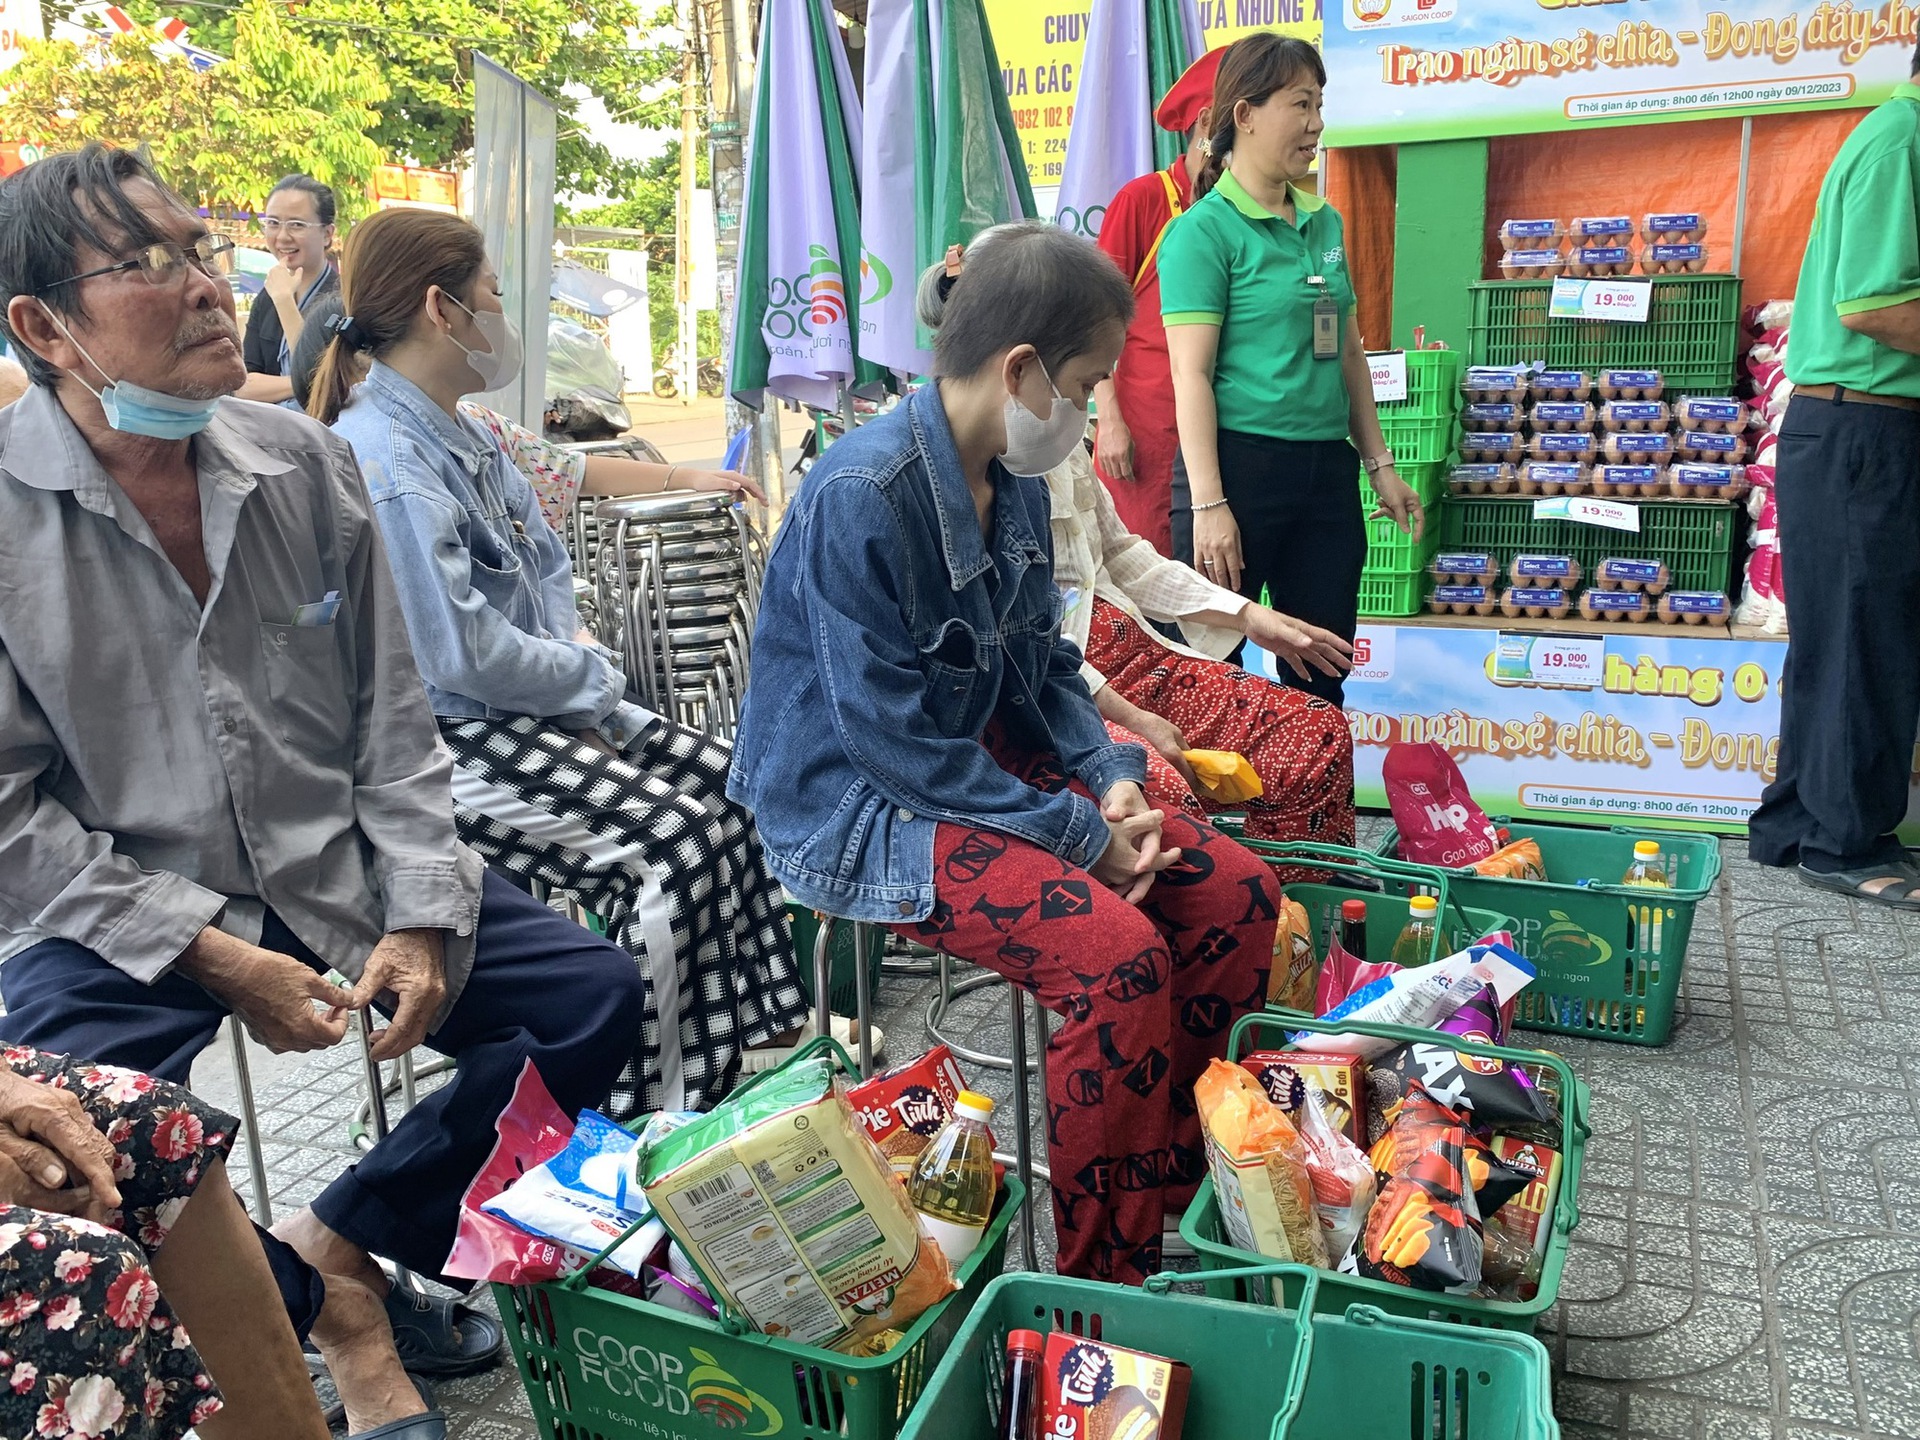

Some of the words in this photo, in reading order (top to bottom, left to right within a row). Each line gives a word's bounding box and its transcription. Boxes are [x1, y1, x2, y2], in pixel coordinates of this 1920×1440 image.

[1401, 13, 1429, 22] SAIGON
[1377, 44, 1455, 84] Trao
[1462, 35, 1548, 83] ngàn
[1550, 28, 1589, 68] sẻ
[1596, 20, 1674, 64] chia
[1702, 12, 1799, 58] Đong
[1808, 0, 1880, 58] đầy
[1035, 59, 1073, 95] CÁC
[1577, 102, 1599, 114] Thời
[1601, 102, 1623, 114] gian
[1625, 99, 1638, 110] áp
[1640, 97, 1671, 110] dụng:
[1672, 95, 1698, 105] 8h00
[1700, 91, 1720, 103] đến
[1722, 89, 1753, 101] 12h00
[1756, 88, 1782, 100] ngày
[1785, 82, 1842, 96] 09/12/2023
[1043, 107, 1063, 128] 102
[1044, 138, 1067, 153] 224
[1042, 162, 1062, 177] 169
[1693, 406, 1711, 414] Select
[1691, 437, 1708, 445] Select
[1609, 471, 1627, 479] Select
[1522, 562, 1540, 570] Select
[1610, 565, 1629, 574] Select
[1515, 593, 1533, 601] Select
[1593, 597, 1612, 605] Select
[1674, 599, 1693, 608] Select
[1604, 654, 1722, 704] hàng
[1734, 661, 1767, 699] 0
[1400, 708, 1500, 753] ngàn
[1503, 711, 1547, 753] sẻ
[1556, 711, 1646, 762] chia
[1533, 792, 1559, 804] Thời
[1561, 795, 1586, 808] gian
[1589, 794, 1604, 808] áp
[1606, 798, 1641, 813] dụng:
[1643, 801, 1673, 811] 8h00
[1676, 801, 1698, 813] đến
[1702, 804, 1738, 816] 12h00
[1442, 846, 1466, 864] Gạo
[1335, 1087, 1348, 1097] 6
[1505, 1158, 1545, 1177] MEIZAN
[1152, 1367, 1165, 1385] GÓI
[575, 1353, 690, 1416] FOOD
[1146, 1387, 1161, 1401] 6
